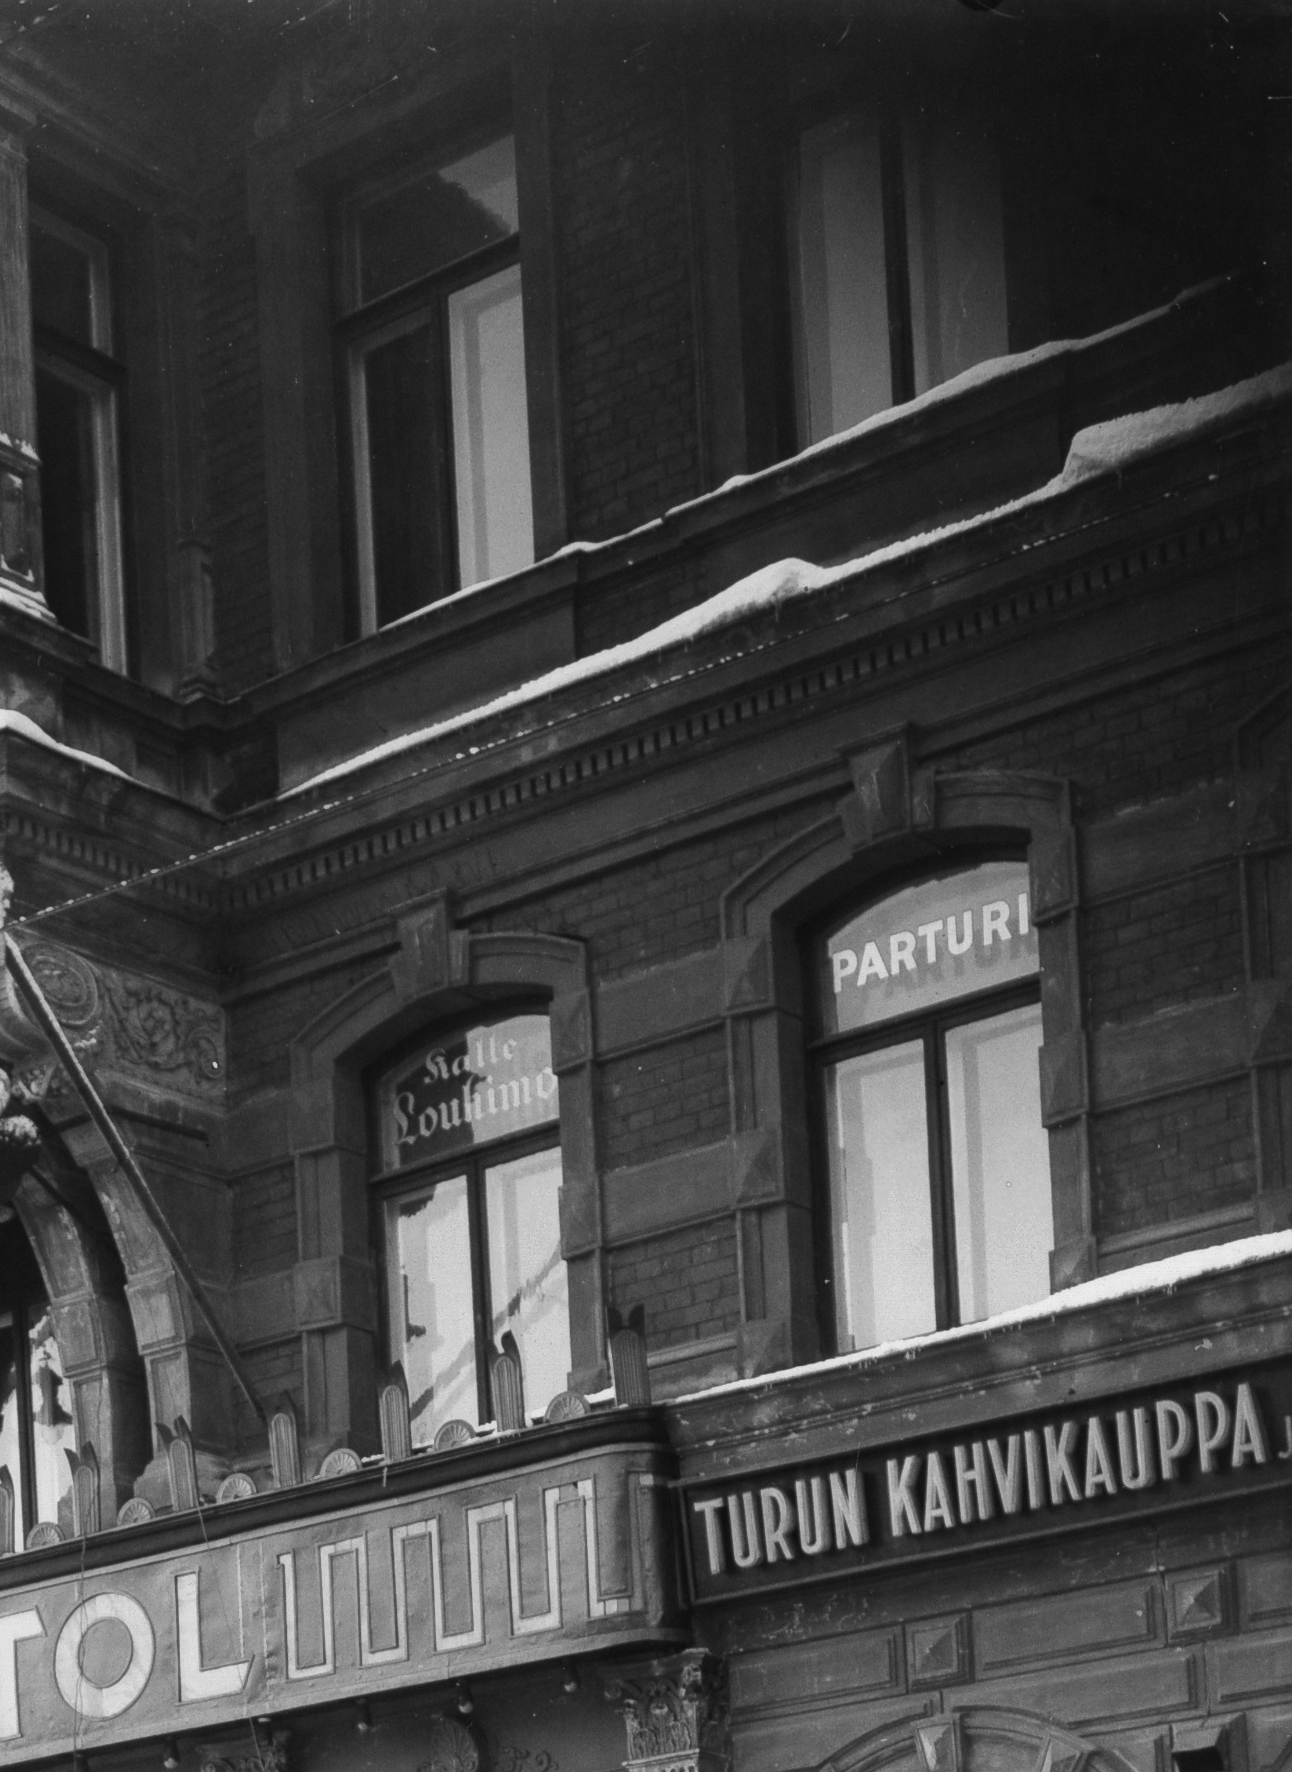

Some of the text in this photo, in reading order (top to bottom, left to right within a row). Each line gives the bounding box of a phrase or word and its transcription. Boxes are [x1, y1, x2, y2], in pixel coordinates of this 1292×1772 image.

[832, 892, 1030, 993] PARTURI
[424, 1033, 517, 1084] Kalle
[392, 1066, 559, 1145] Louhimo
[693, 1468, 870, 1575] TURUN
[885, 1382, 1267, 1537] KAHVIKAUPPA
